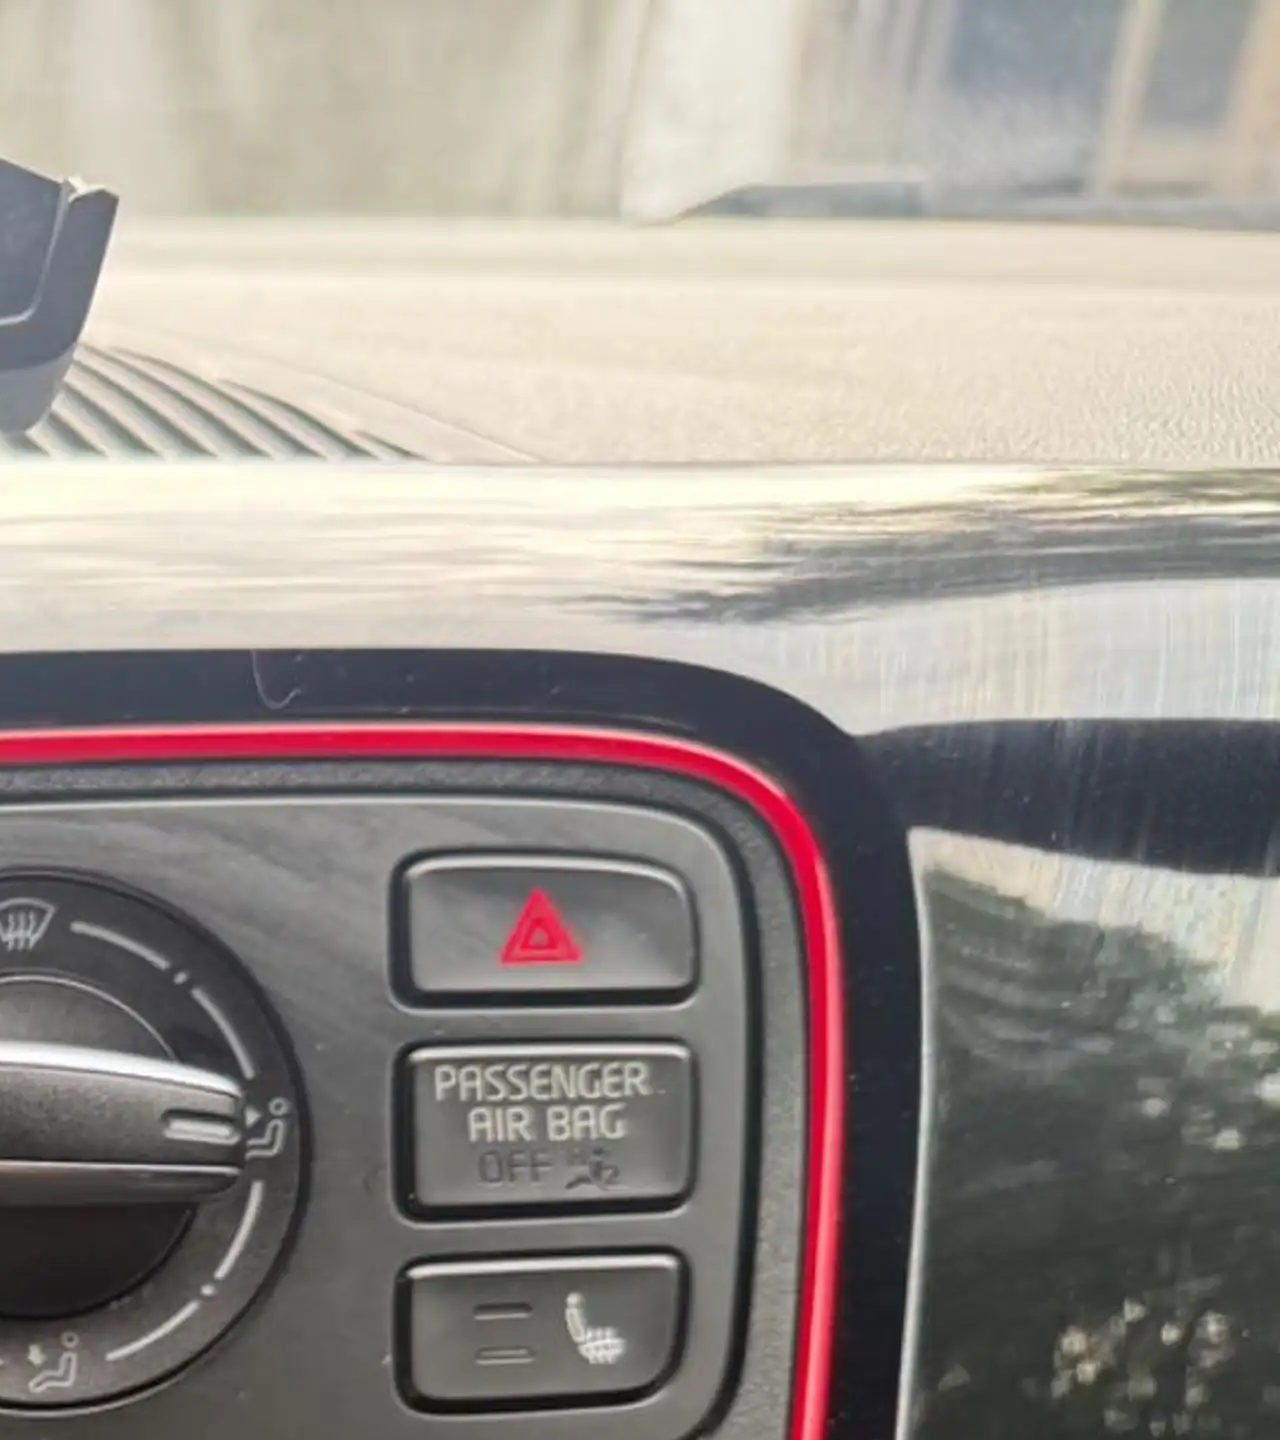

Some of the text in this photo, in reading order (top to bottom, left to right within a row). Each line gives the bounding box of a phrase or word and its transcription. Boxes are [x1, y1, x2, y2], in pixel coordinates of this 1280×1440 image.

[434, 1060, 652, 1102] PASSENGER
[467, 1102, 627, 1144] AIR BAG
[479, 1148, 553, 1186] OFF
